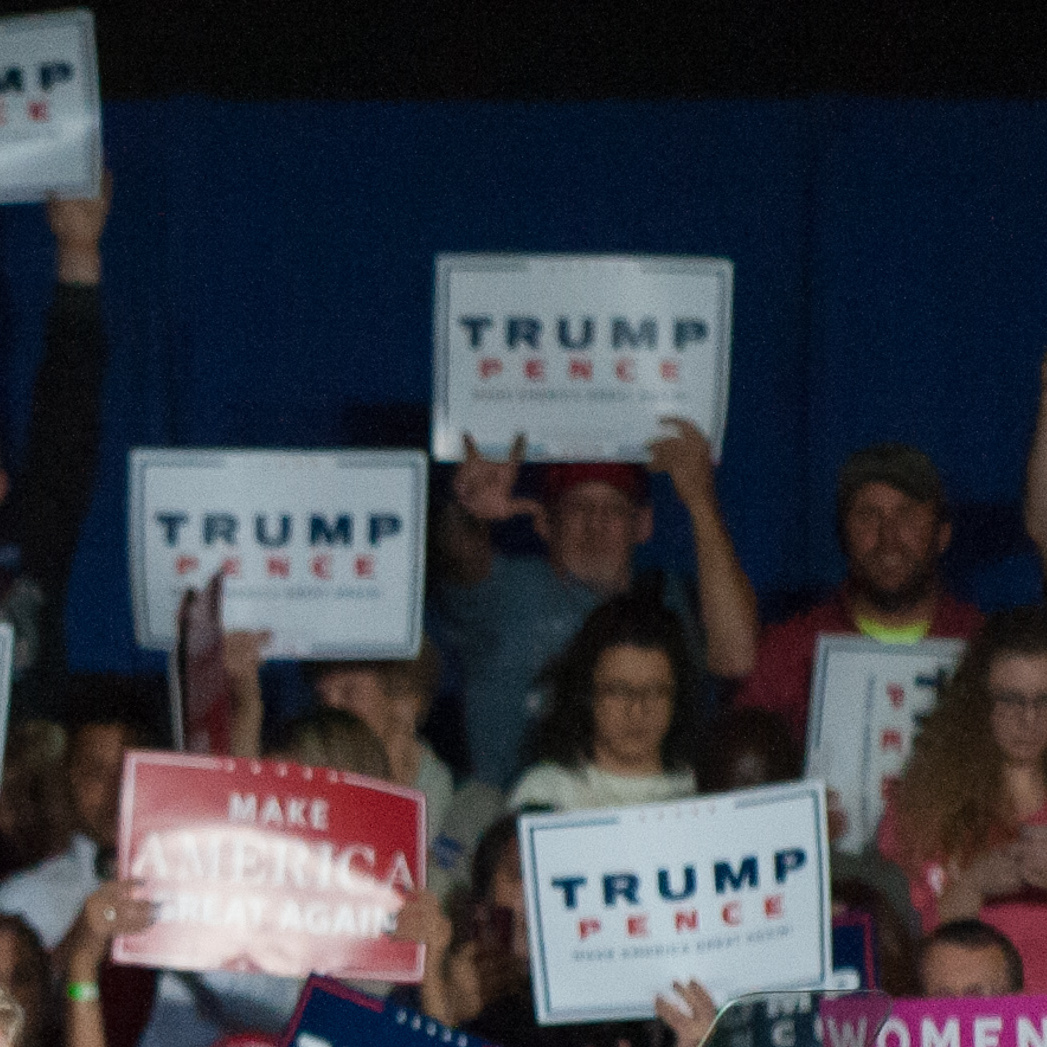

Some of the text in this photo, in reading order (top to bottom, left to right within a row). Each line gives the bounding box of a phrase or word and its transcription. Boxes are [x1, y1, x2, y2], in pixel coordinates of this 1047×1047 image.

[458, 314, 709, 350] TRUMP
[476, 356, 681, 384] PENCE
[155, 511, 402, 548] TRUMP
[227, 792, 329, 831] MAKE
[130, 832, 415, 891] AMERICA
[551, 847, 807, 910] TRUMP
[578, 894, 784, 941] PENCE
